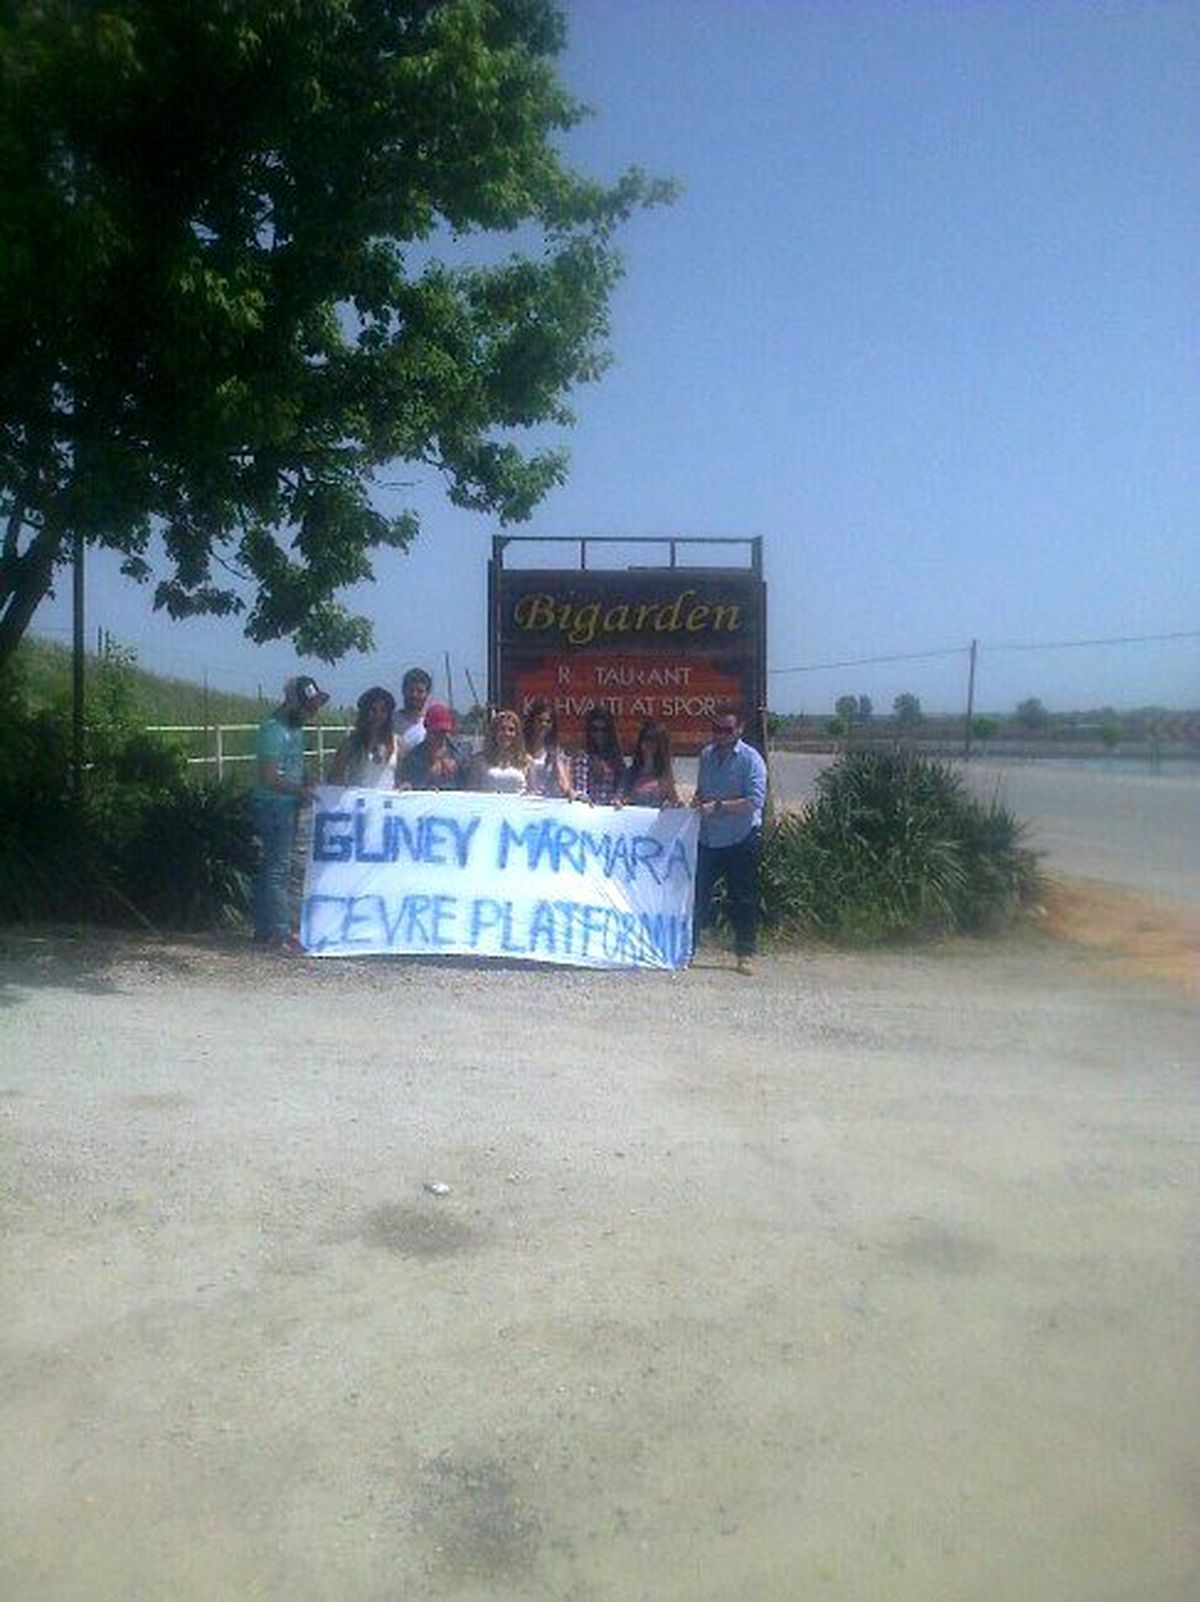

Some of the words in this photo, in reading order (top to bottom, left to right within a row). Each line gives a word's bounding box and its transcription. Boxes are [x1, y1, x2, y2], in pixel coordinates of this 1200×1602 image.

[514, 590, 743, 644] Bigarden
[558, 665, 692, 685] RTAUANT
[313, 798, 481, 870] GÜNEY
[498, 817, 694, 886] MARMARA
